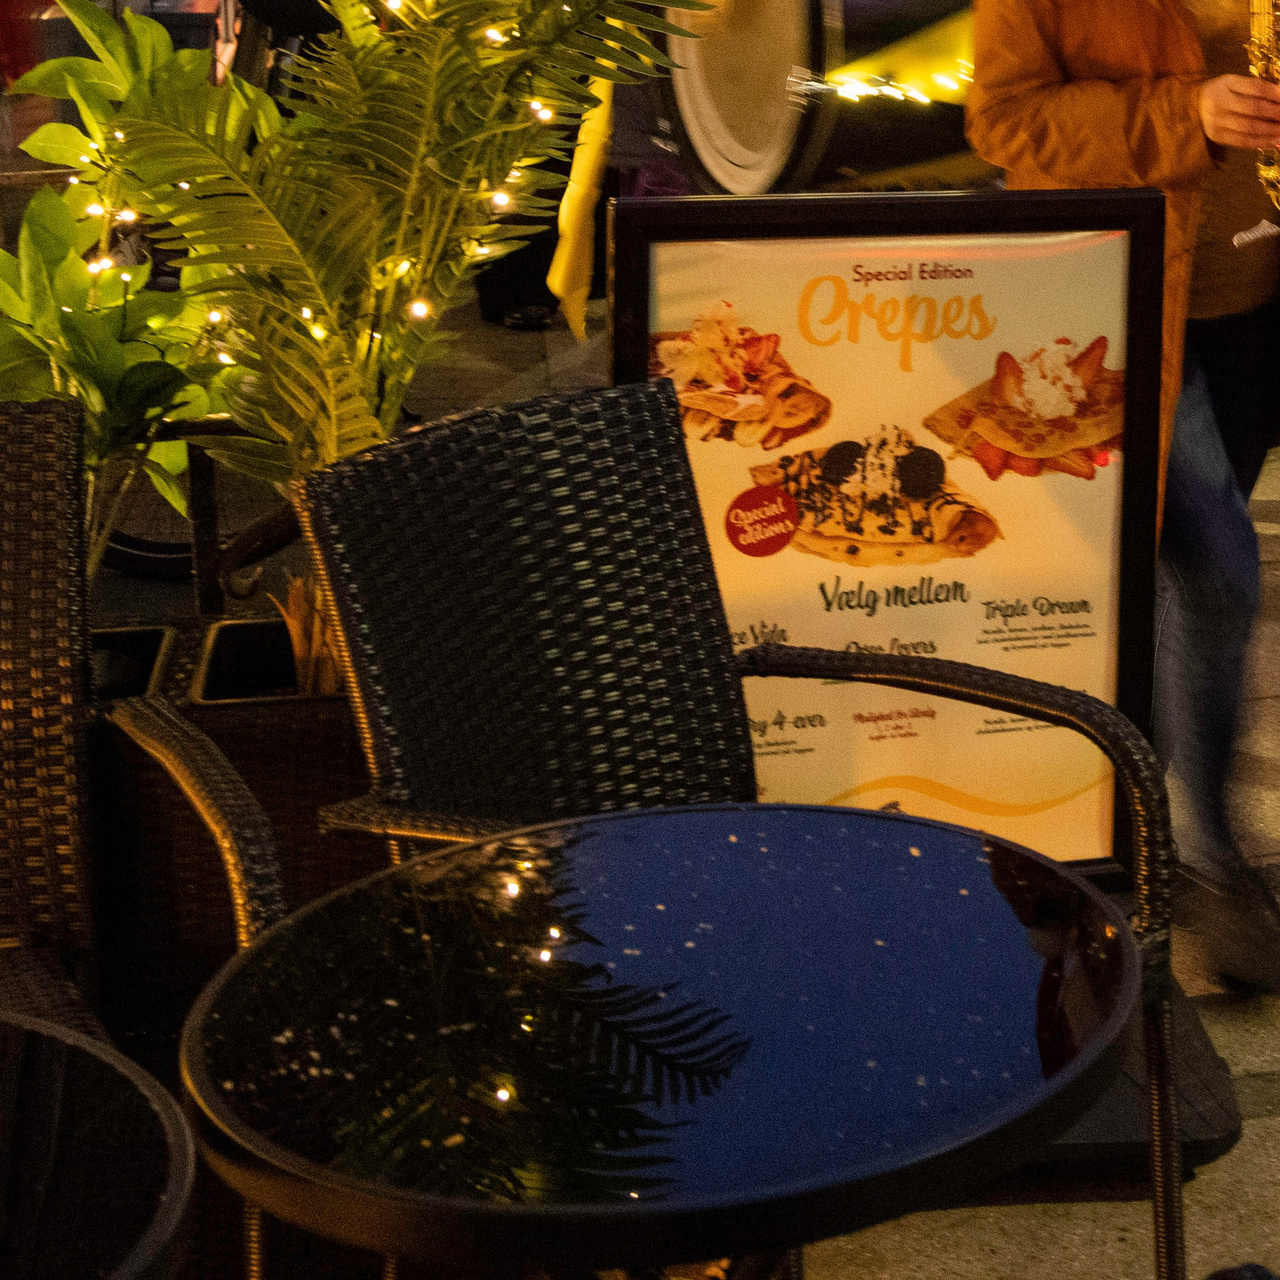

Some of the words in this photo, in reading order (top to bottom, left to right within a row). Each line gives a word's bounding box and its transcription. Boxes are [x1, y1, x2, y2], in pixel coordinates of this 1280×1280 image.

[852, 263, 913, 287] Special
[918, 262, 974, 281] Edition
[797, 275, 998, 373] Crepes
[729, 497, 787, 527] Special
[819, 575, 878, 616] Vælg
[884, 576, 971, 608] mellem
[980, 598, 1029, 626] Triple
